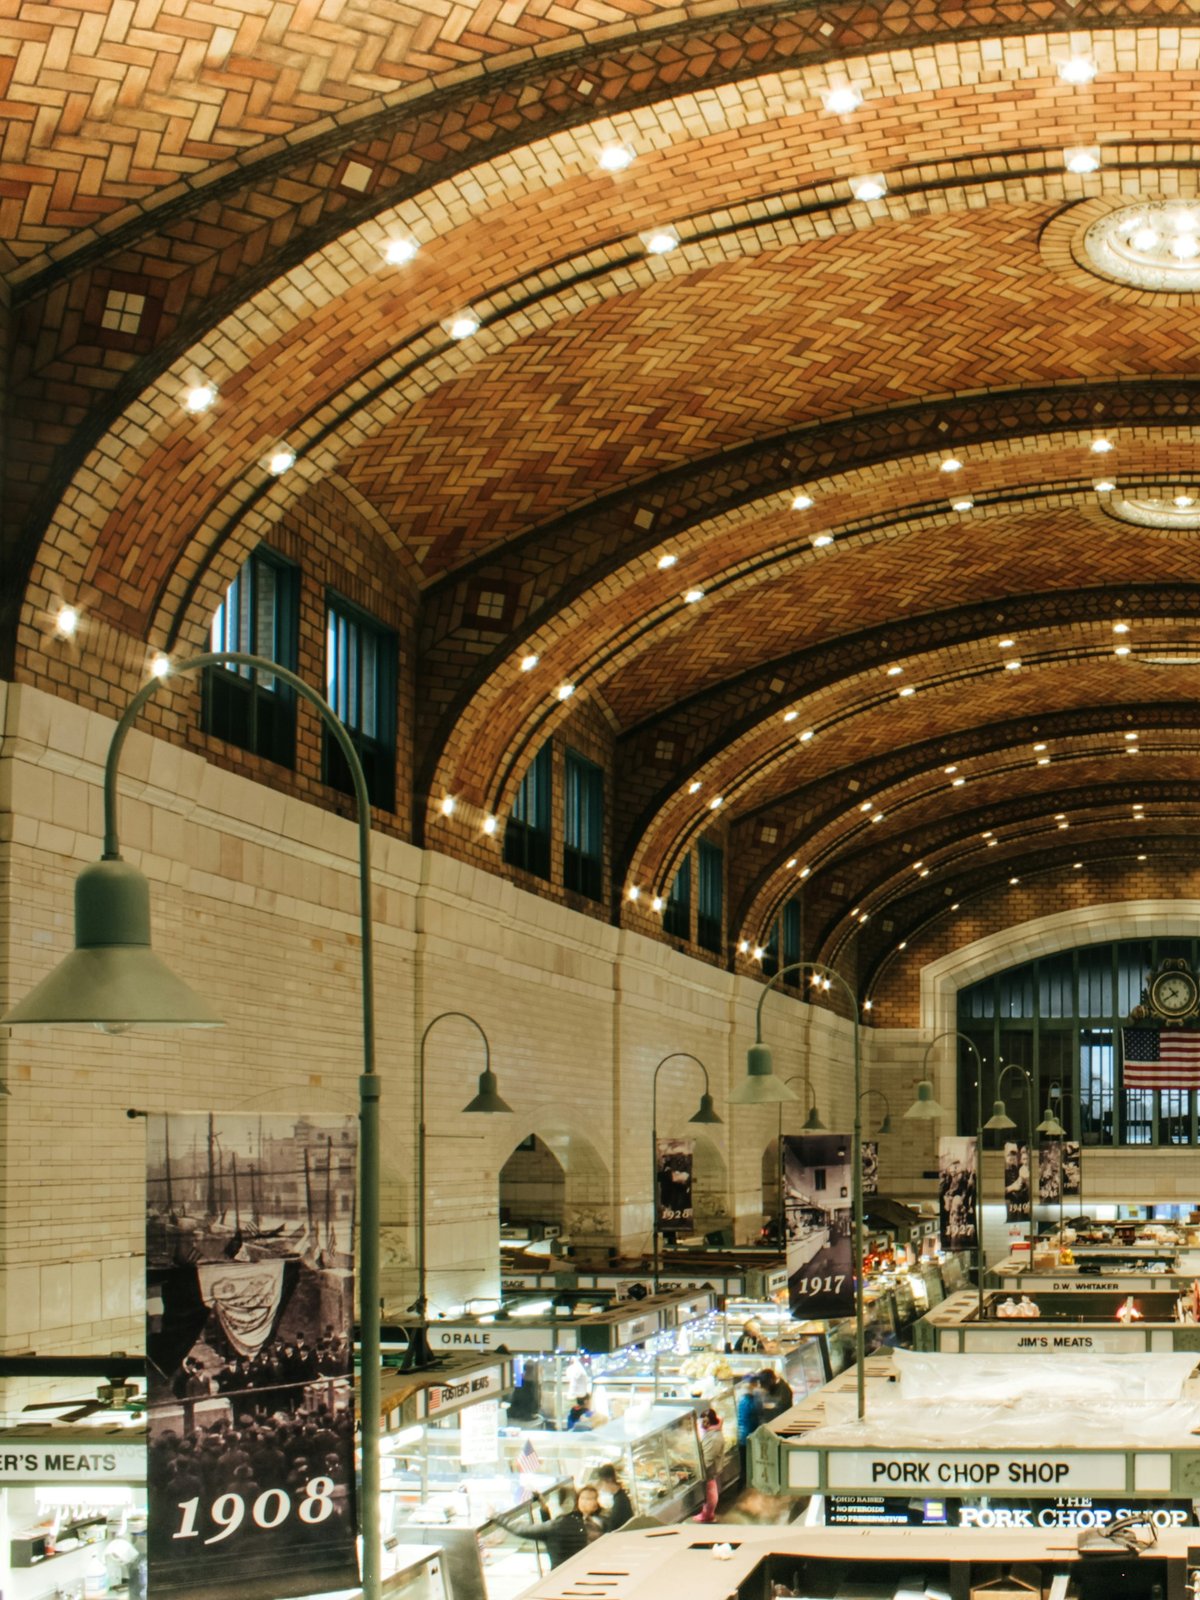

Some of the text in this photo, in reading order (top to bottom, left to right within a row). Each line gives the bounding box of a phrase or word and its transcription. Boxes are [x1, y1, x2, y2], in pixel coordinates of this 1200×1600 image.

[945, 1223, 975, 1238] 1927
[502, 1280, 525, 1288] SAGE
[799, 1275, 846, 1297] 1917
[441, 1333, 491, 1344] ORALE
[1017, 1337, 1093, 1347] JIM'S MEATS
[471, 1375, 490, 1393] MEATS
[45, 1454, 117, 1471] MEATS
[872, 1461, 1070, 1483] PORK CHOP SHOP
[172, 1476, 335, 1545] 1908
[1055, 1497, 1092, 1507] THE
[959, 1508, 1188, 1528] PORK CHOP SOP
